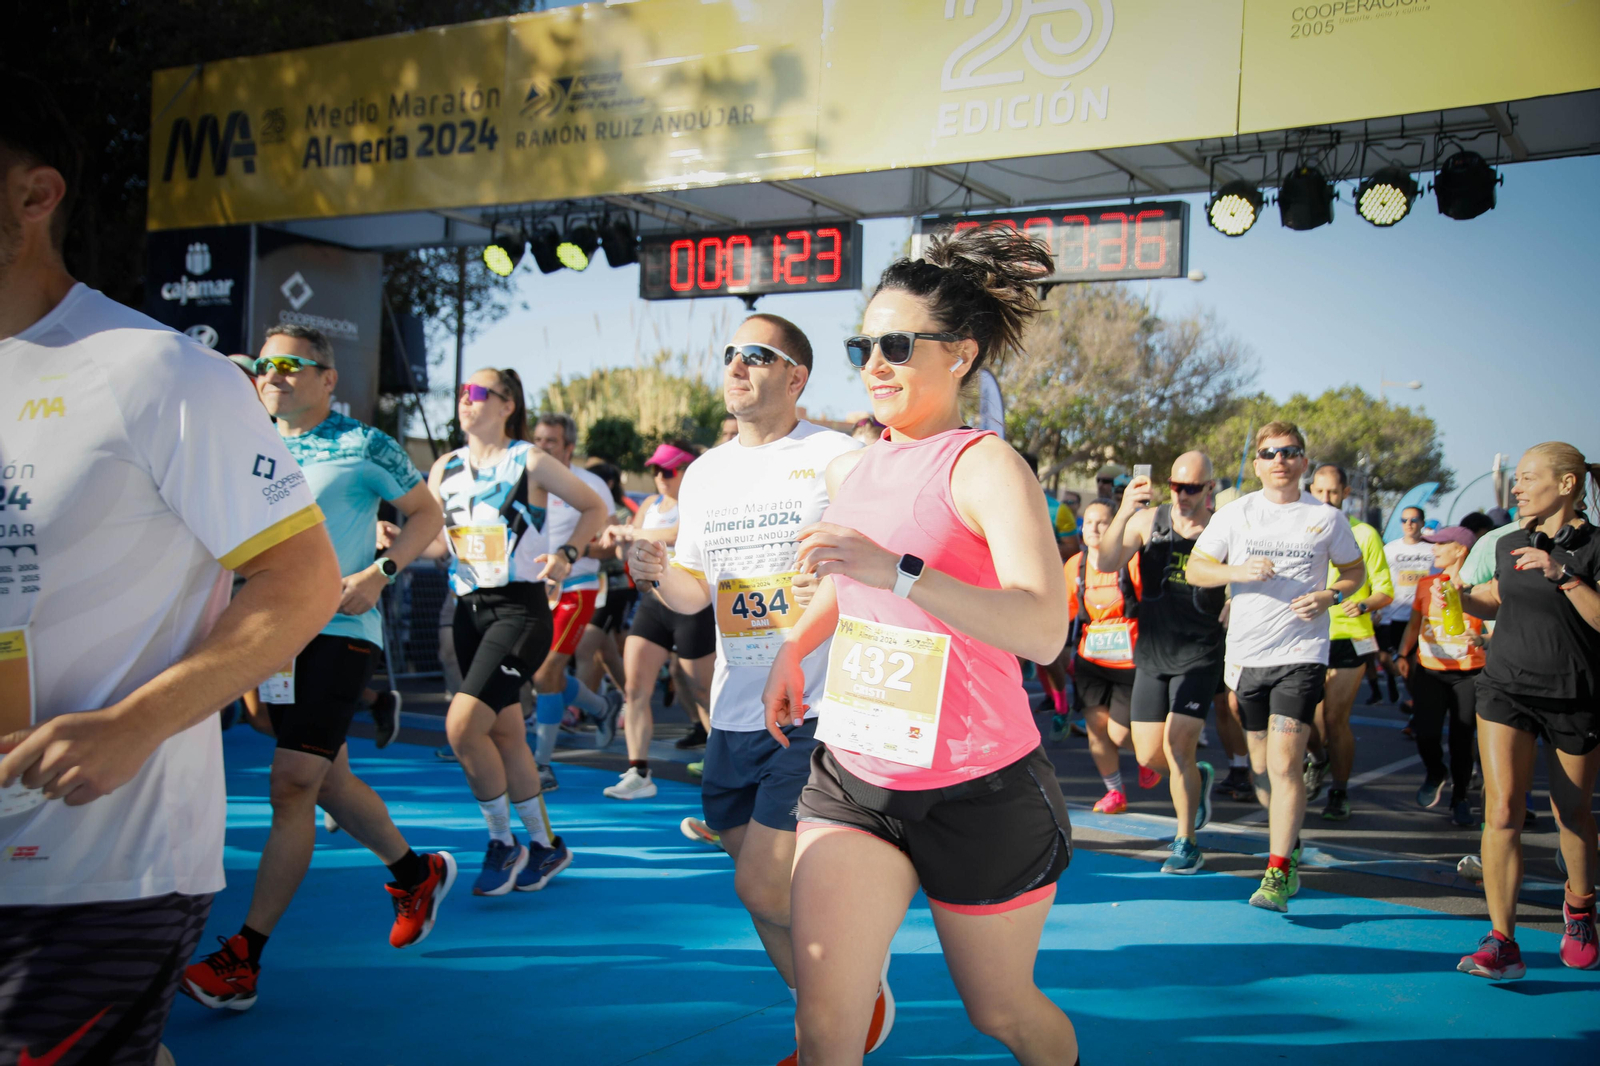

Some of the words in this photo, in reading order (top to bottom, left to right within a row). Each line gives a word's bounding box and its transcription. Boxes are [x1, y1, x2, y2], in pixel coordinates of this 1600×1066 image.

[1291, 0, 1427, 22] COOPERAC
[1290, 19, 1335, 39] 2005
[304, 97, 379, 131] Medio
[388, 82, 500, 120] Maratón
[938, 81, 1110, 137] EDICIÓN
[515, 121, 587, 149] RAMÓN
[595, 117, 645, 140] RUIZ
[651, 102, 756, 136] ANDÚJAR
[303, 128, 409, 169] Almería
[415, 116, 499, 158] 2024
[161, 275, 235, 306] cajamar
[266, 486, 291, 506] 2005
[706, 506, 739, 518] Medio
[744, 498, 803, 514] Maratón
[703, 515, 755, 535] Almería
[758, 511, 802, 528] 2024
[466, 534, 486, 555] 15
[703, 535, 732, 548] RAMÓN
[735, 534, 755, 544] RUIZ
[1244, 538, 1273, 548] Medio
[1275, 539, 1315, 550] Maratón
[1246, 547, 1284, 557] Almería
[1285, 549, 1314, 559] 2024
[731, 588, 790, 619] 434
[750, 618, 770, 627] DANI
[879, 635, 898, 645] 2024
[1089, 630, 1125, 647] 1374
[841, 641, 915, 692] 432
[852, 683, 887, 700] CRISTI
